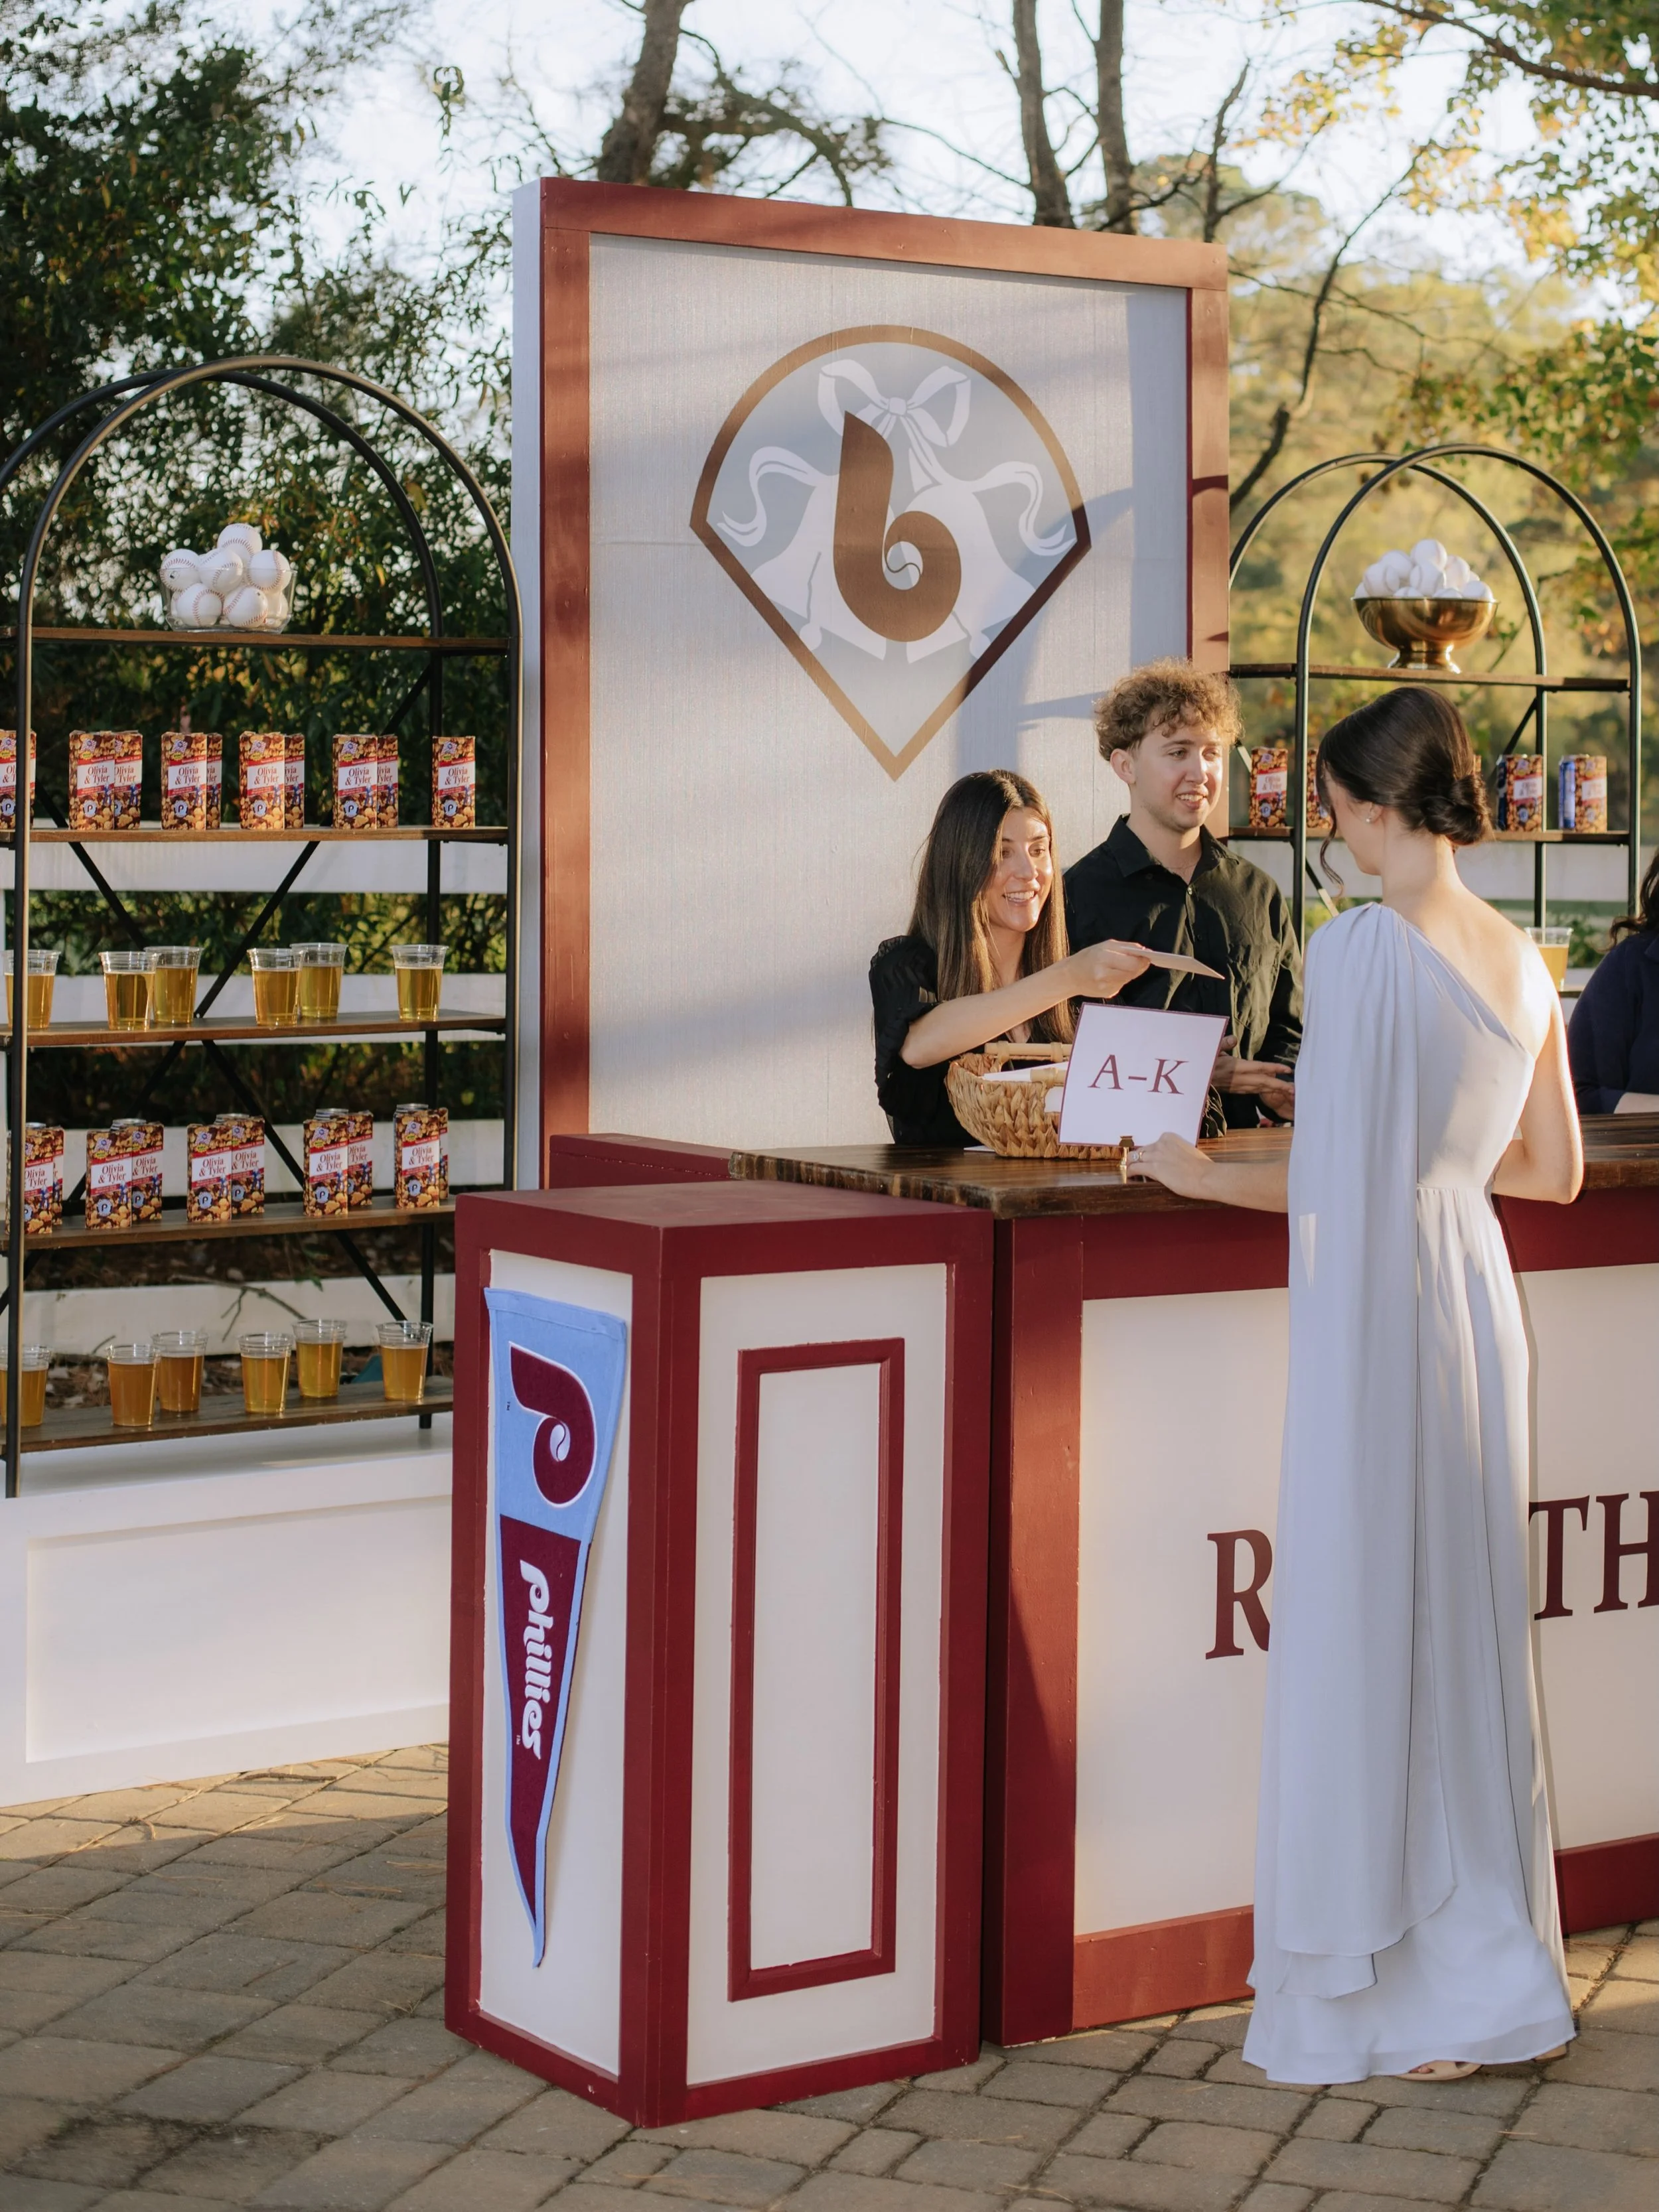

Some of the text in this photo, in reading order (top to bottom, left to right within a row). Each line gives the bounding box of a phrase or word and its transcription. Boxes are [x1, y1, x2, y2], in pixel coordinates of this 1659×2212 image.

[88, 765, 108, 775] Olivia
[179, 766, 198, 775] Olivia
[257, 766, 277, 775] Olivia
[348, 768, 369, 777] Olivia
[377, 767, 390, 776] livia
[448, 768, 468, 776] Olivia
[93, 774, 109, 784] Tyler
[119, 774, 136, 783] Tyler
[184, 775, 201, 785] Tyler
[262, 775, 279, 785] Tyler
[285, 775, 299, 784] yler
[354, 777, 372, 786] Tyler
[453, 776, 470, 786] Tyler
[235, 1151, 257, 1160] Olivia
[412, 1146, 432, 1156] Olivia
[136, 1156, 156, 1166] Olivia
[320, 1151, 340, 1162] Olivia
[351, 1154, 368, 1163] Tyler
[418, 1155, 435, 1166] Tyler
[202, 1157, 224, 1168] Olivia
[242, 1160, 259, 1170] Tyler
[316, 1161, 342, 1172] & Tyler
[102, 1164, 123, 1174] Olivia
[141, 1166, 158, 1176] Tyler
[199, 1166, 226, 1177] & Tyler
[29, 1177, 47, 1188] Tyler
[98, 1172, 126, 1184] & Tyler
